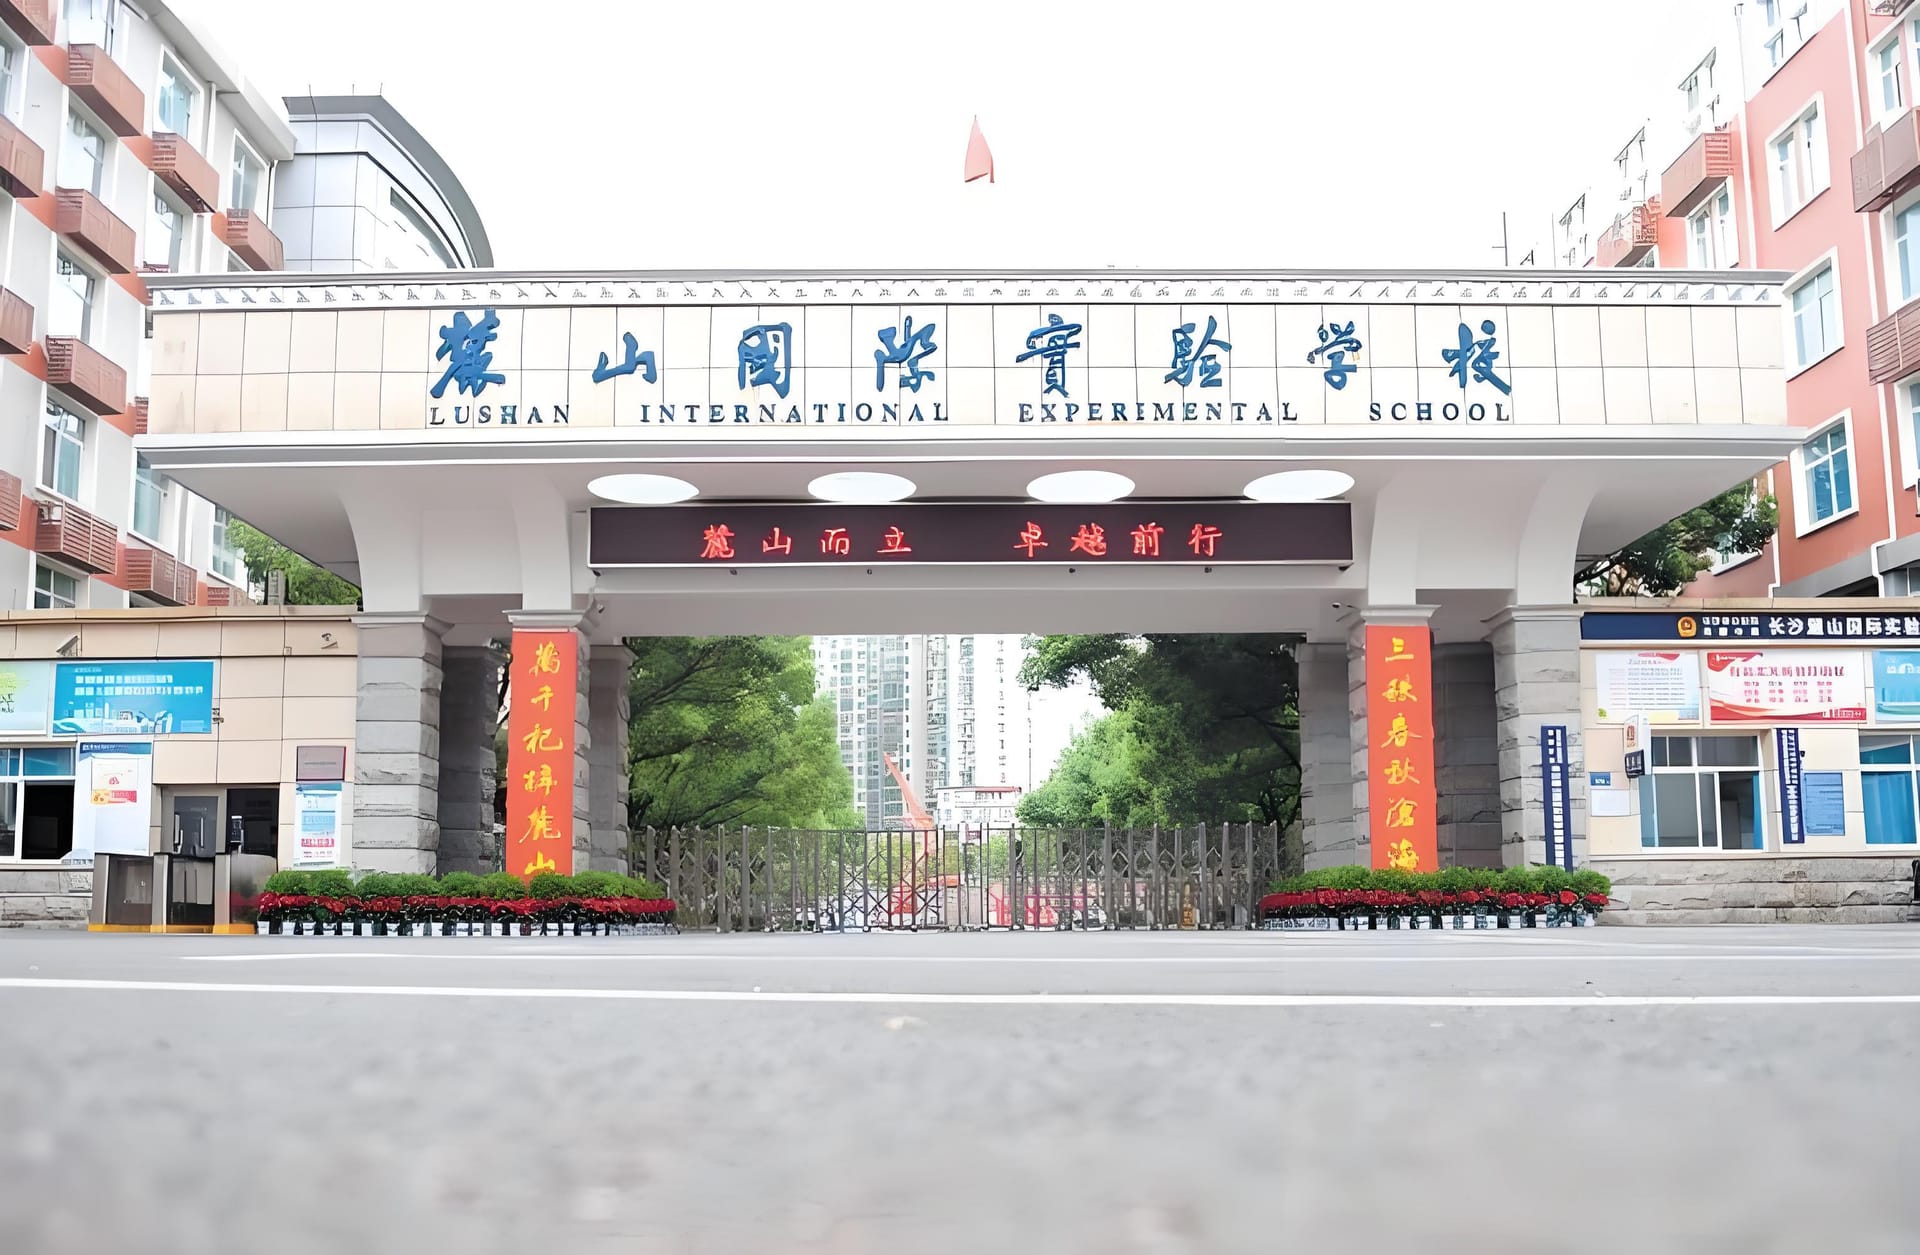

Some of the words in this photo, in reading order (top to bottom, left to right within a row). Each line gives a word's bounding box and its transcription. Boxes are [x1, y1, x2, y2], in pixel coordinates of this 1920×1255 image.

[430, 405, 569, 424] LUSHAN
[641, 402, 949, 423] INTERNATIONAL
[1018, 402, 1298, 422] EXPERIMENTAL
[1369, 402, 1511, 421] SCHOOL
[700, 524, 912, 559] 麓山而立
[1014, 521, 1223, 558] 卓越前行
